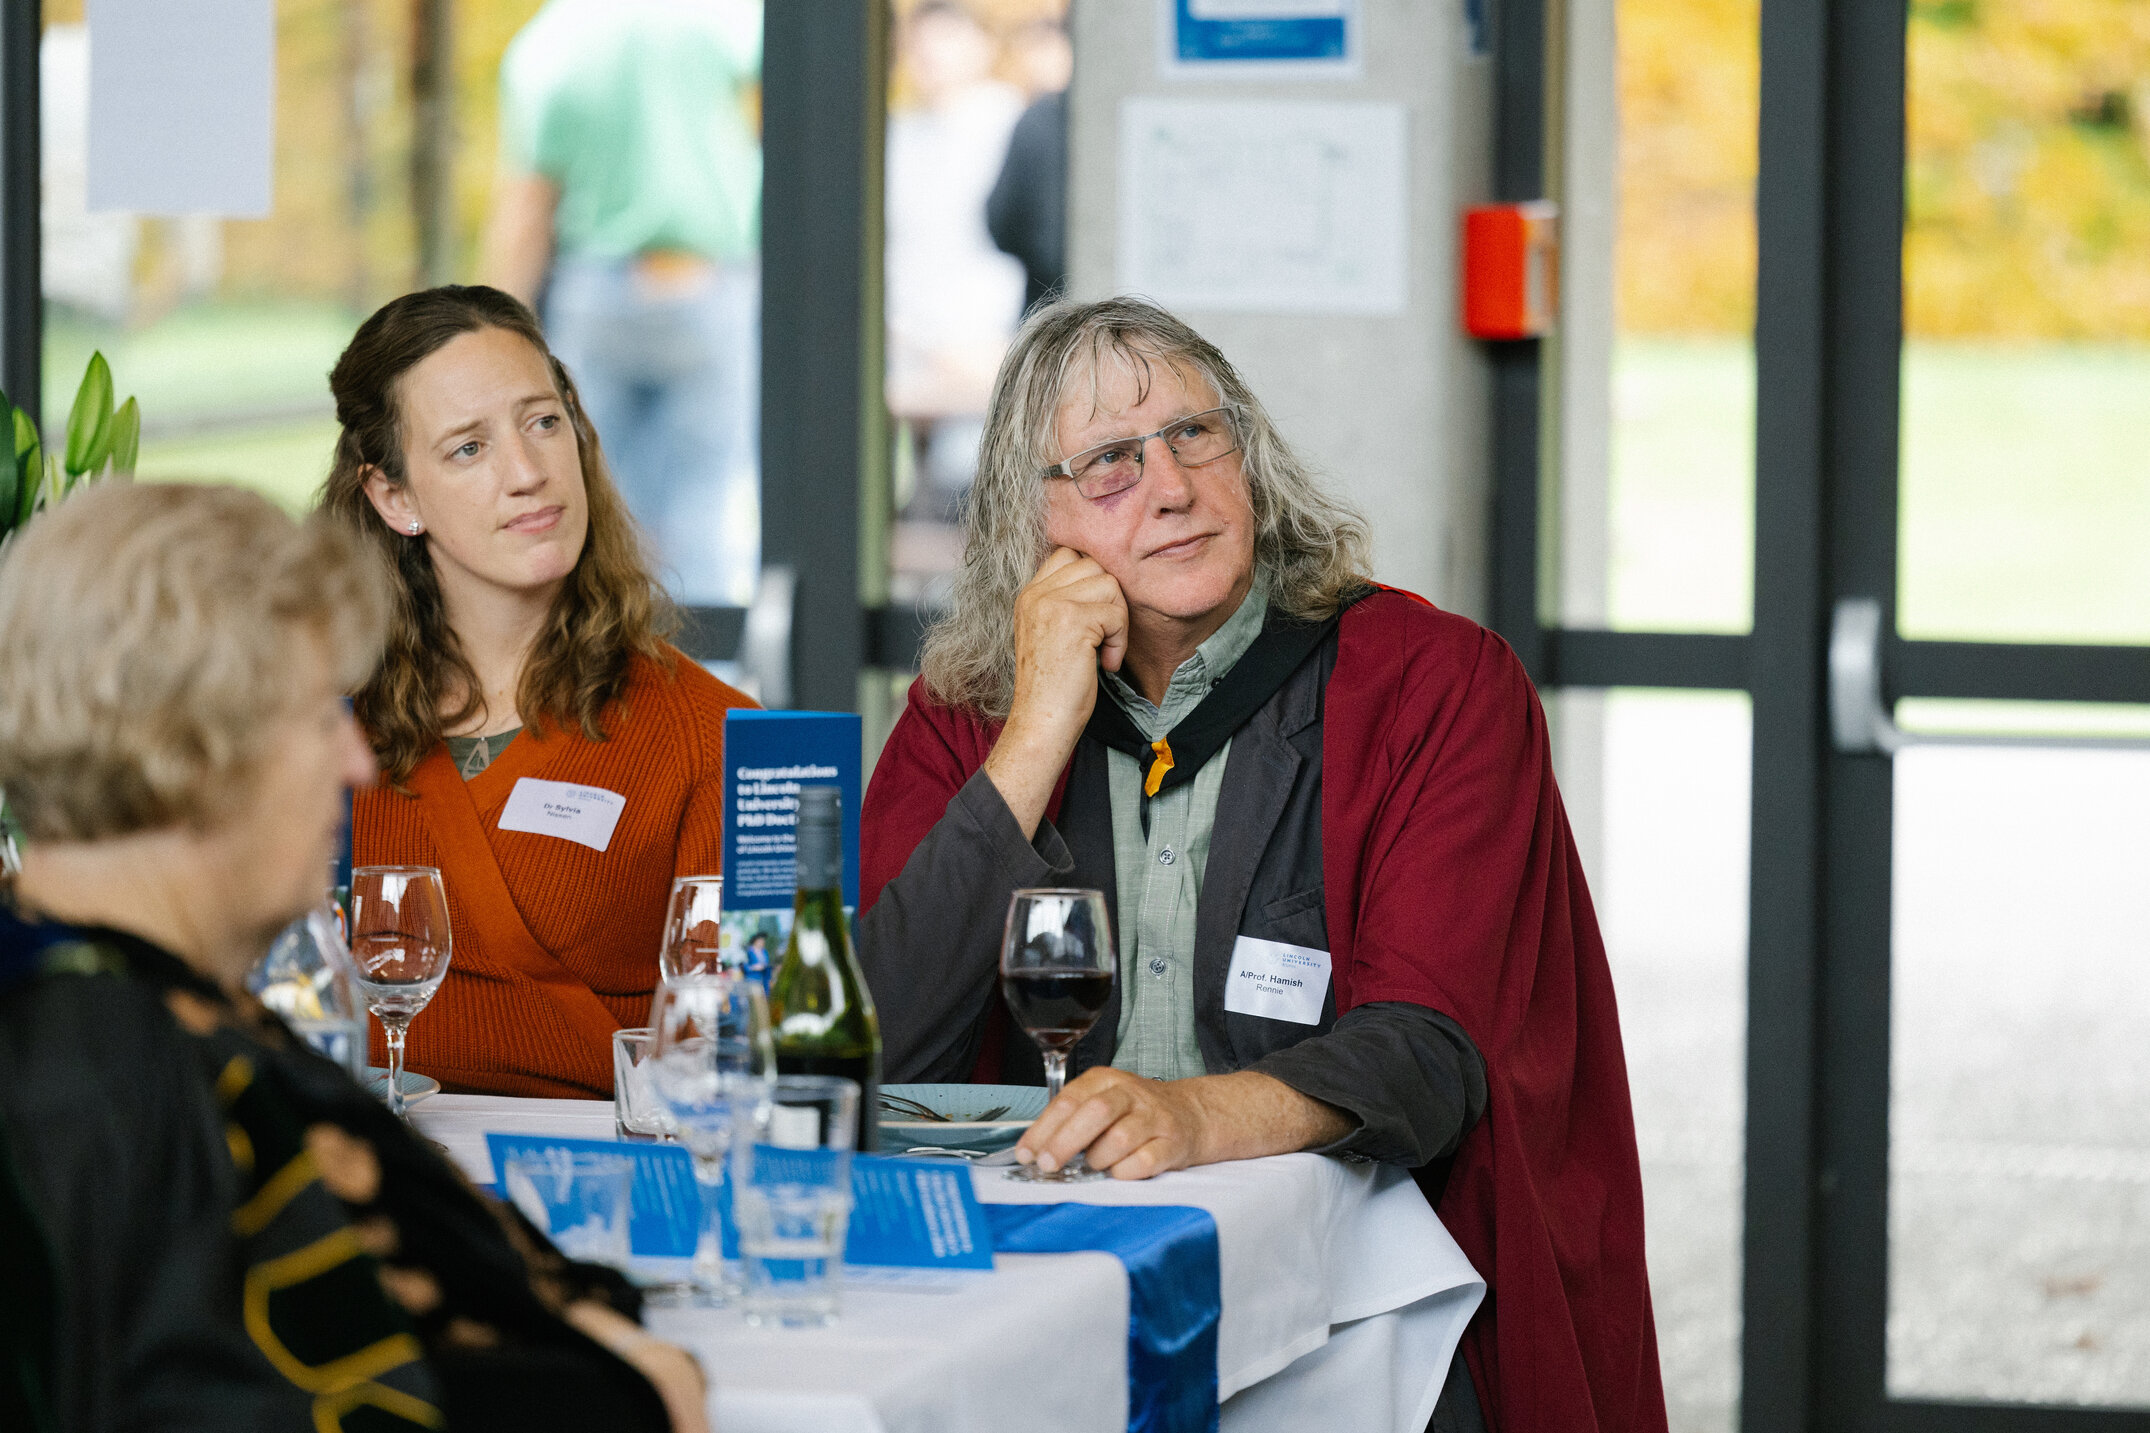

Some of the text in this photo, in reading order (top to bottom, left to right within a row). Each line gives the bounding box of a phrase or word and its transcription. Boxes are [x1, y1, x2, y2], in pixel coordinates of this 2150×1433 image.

[737, 764, 838, 781] Congratulations
[737, 781, 800, 796] to Lincoln
[555, 804, 581, 814] Sylvia
[737, 796, 800, 812] University
[737, 812, 800, 827] PhD Doct
[1282, 953, 1310, 961] LINCOLN
[1282, 958, 1321, 968] UNIVERSITY
[1240, 970, 1303, 988] A/Prof. Hamish
[1256, 984, 1283, 995] Rennie
